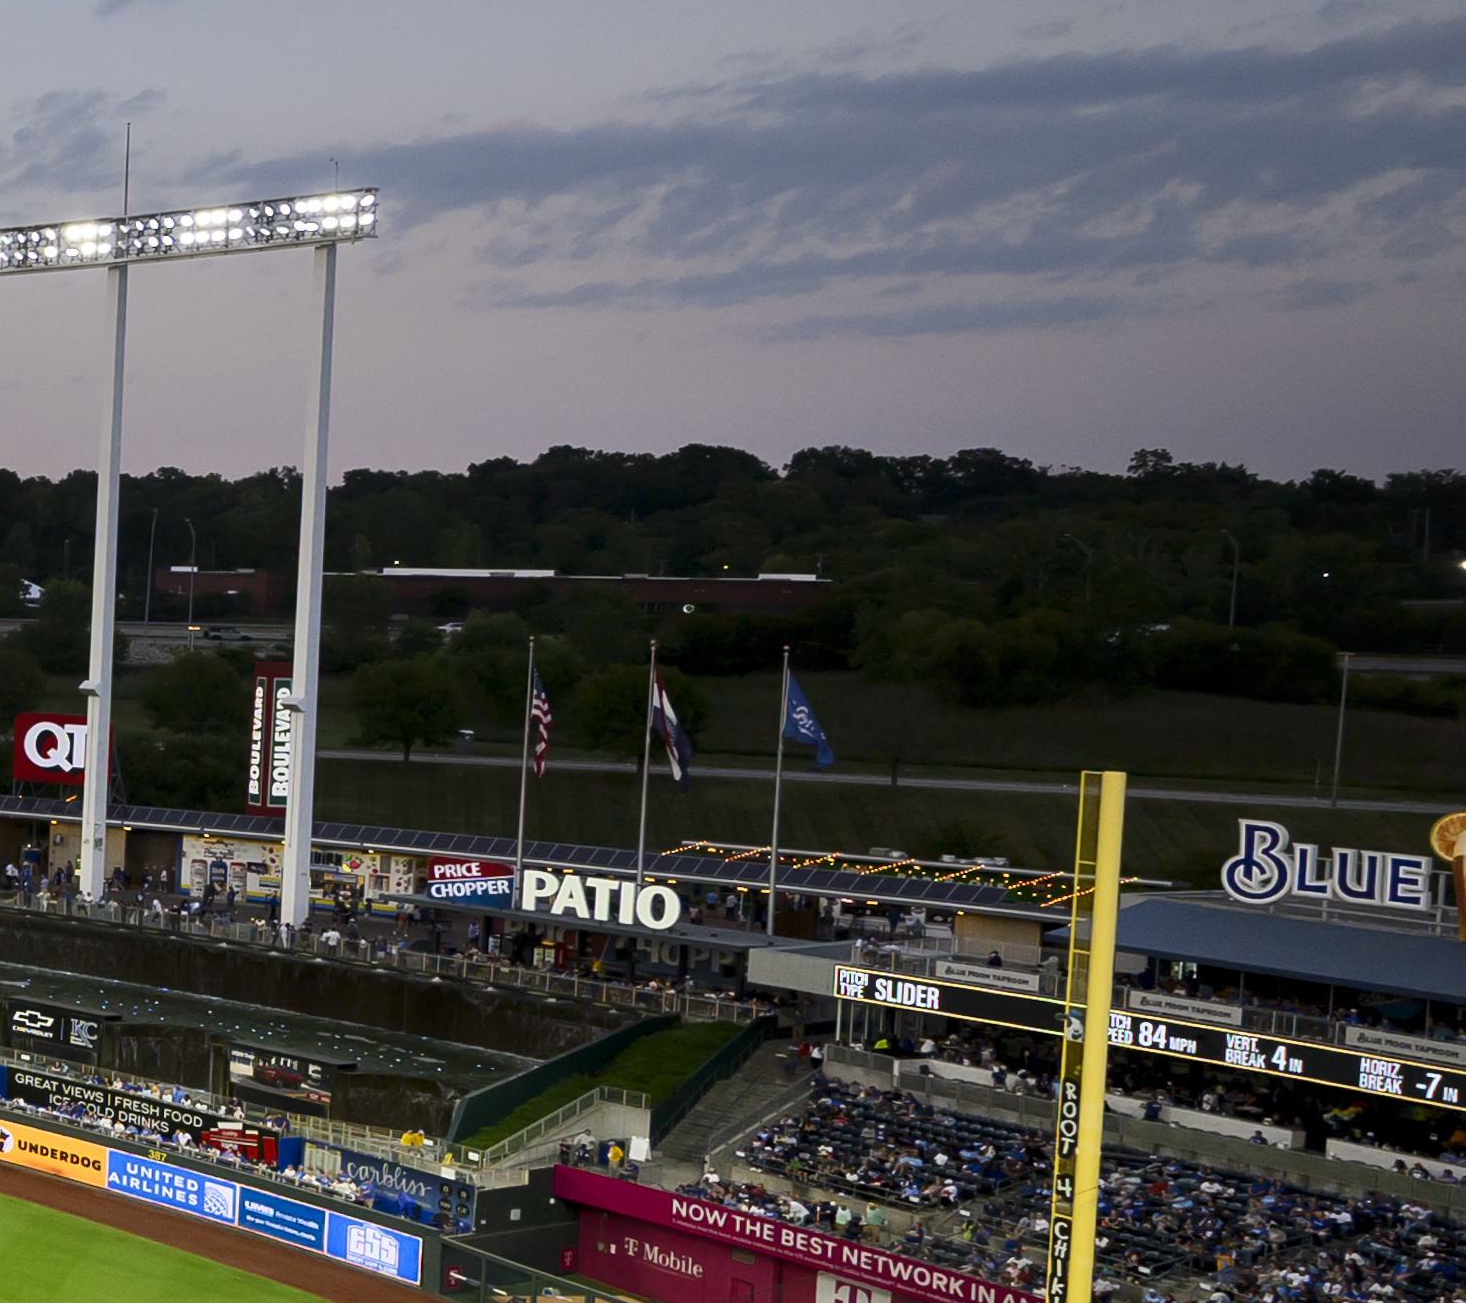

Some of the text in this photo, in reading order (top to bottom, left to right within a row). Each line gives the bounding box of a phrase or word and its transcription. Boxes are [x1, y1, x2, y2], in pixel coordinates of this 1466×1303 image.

[249, 687, 263, 794] BOULEVARD
[433, 862, 481, 878] PRICE
[430, 879, 510, 897] CHOPPER
[522, 869, 681, 930] PATIO
[840, 970, 868, 987] PITCH
[840, 983, 863, 999] TYPE
[875, 979, 940, 1010] SLIDER
[13, 1025, 53, 1038] CHEVROLET
[1138, 1023, 1196, 1054] 84 MPH
[1227, 1034, 1258, 1052] VERT.
[1225, 1049, 1265, 1069] BREAK
[1289, 1059, 1302, 1073] IN
[1361, 1058, 1403, 1079] HORIZ.
[1359, 1074, 1402, 1094] BREAK
[1416, 1073, 1457, 1103] -7 IN
[15, 1073, 202, 1127] GREAT VIEWS FRESH FOOD
[119, 1111, 169, 1132] DRINKS
[1060, 1082, 1076, 1154] ROOT
[17, 1140, 101, 1171] UNDERDOG
[148, 1149, 167, 1161] 387
[109, 1172, 198, 1205] AIRLINES
[126, 1162, 198, 1191] UNITED
[347, 1162, 431, 1196] carbliss
[245, 1201, 274, 1217] UMB
[644, 1243, 702, 1277] Mobile
[672, 1199, 728, 1227] NOW
[731, 1214, 773, 1241] THE
[781, 1228, 836, 1255] BEST
[843, 1241, 964, 1298] NETWORK
